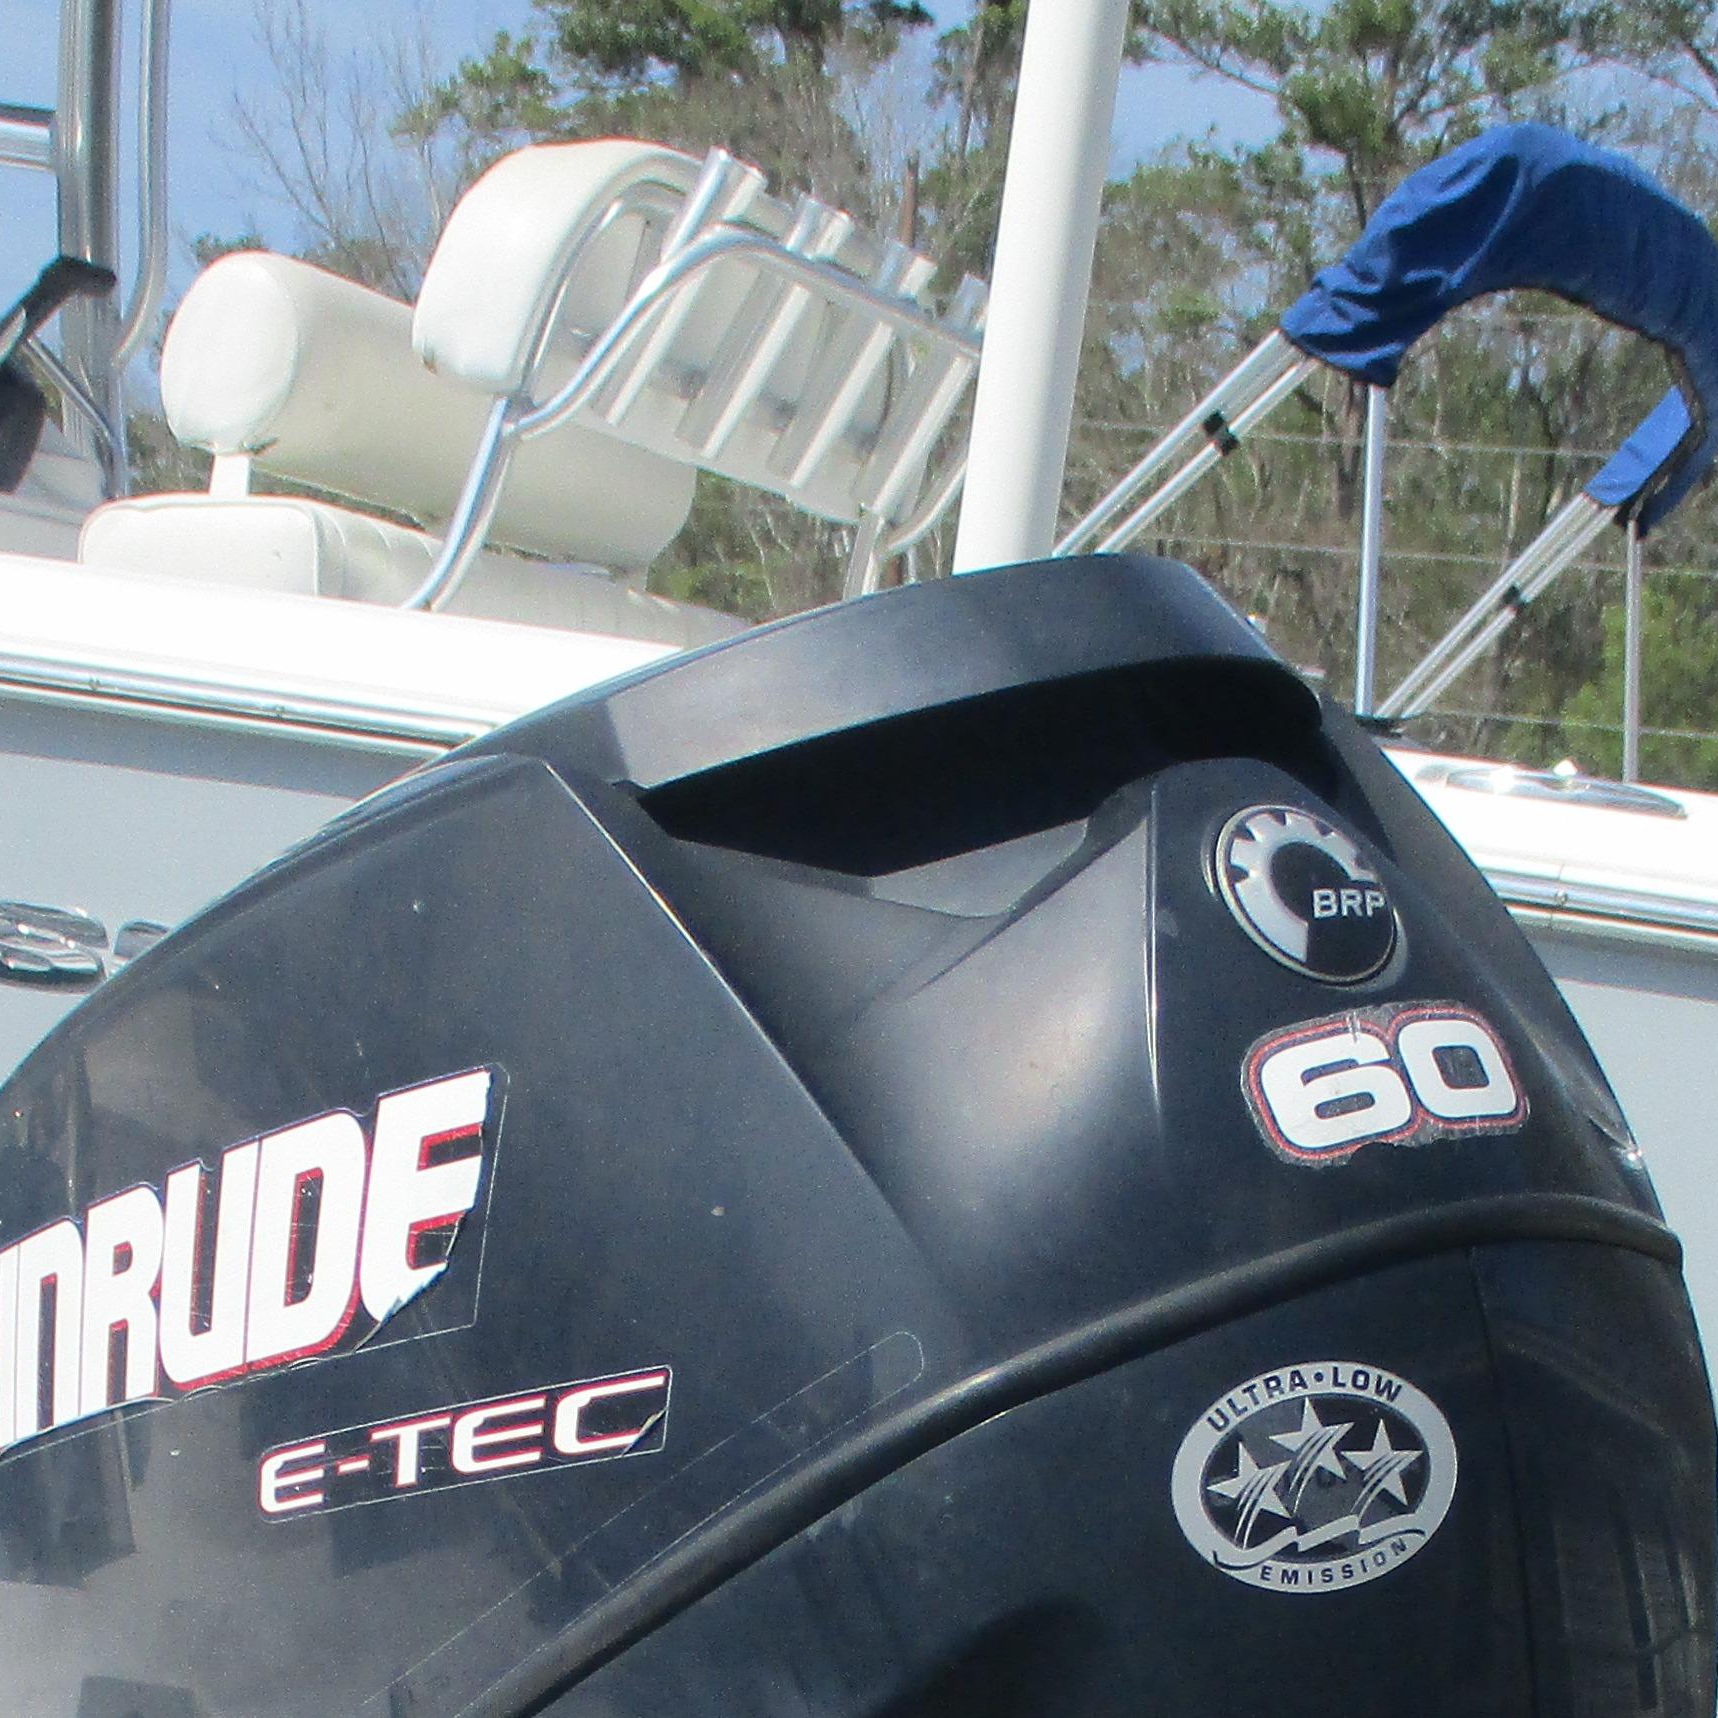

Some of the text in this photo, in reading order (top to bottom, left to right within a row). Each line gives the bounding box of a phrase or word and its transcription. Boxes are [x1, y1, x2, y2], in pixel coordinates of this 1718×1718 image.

[1313, 887, 1384, 919] BRP
[1253, 1010, 1524, 1156] 60
[259, 1371, 668, 1515] E-TEC
[1259, 1537, 1409, 1586] EMISSION
